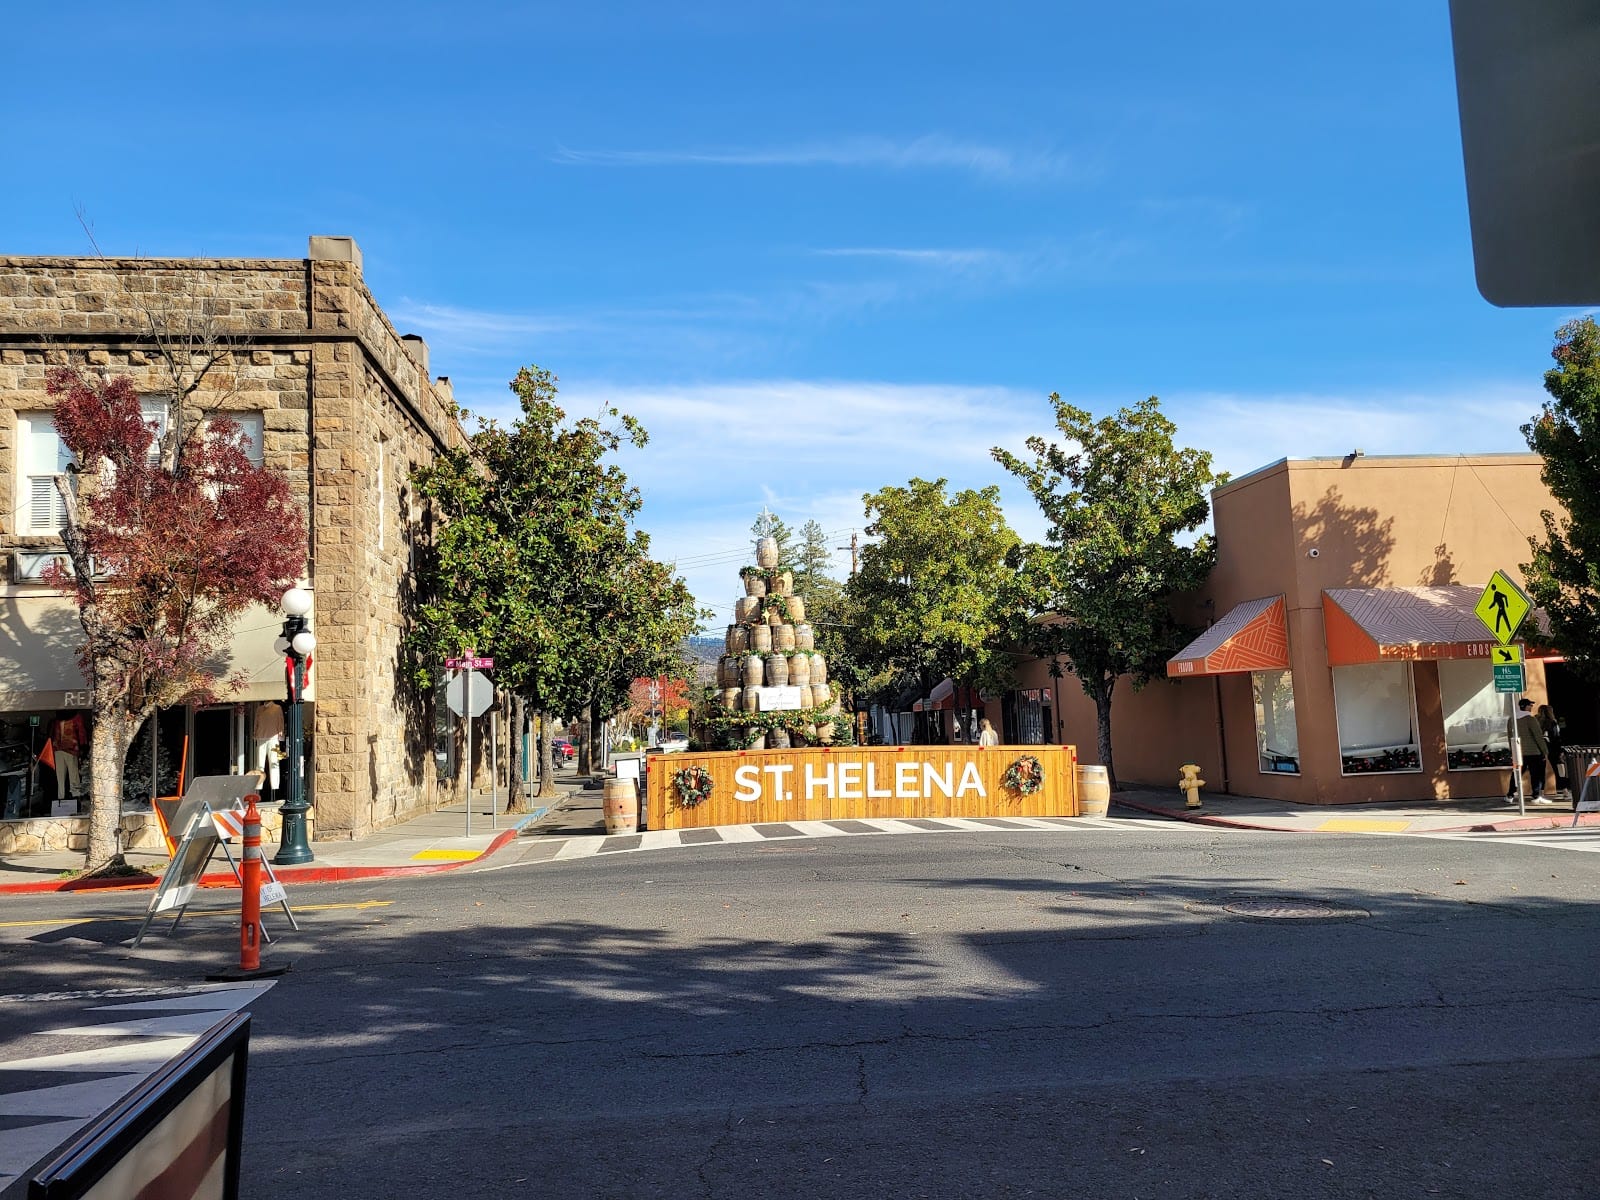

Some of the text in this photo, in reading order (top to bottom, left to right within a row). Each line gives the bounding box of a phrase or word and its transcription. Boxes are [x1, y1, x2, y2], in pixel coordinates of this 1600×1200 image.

[1467, 643, 1497, 656] EROS
[455, 660, 473, 668] Main
[734, 761, 987, 802] ST. HELENA
